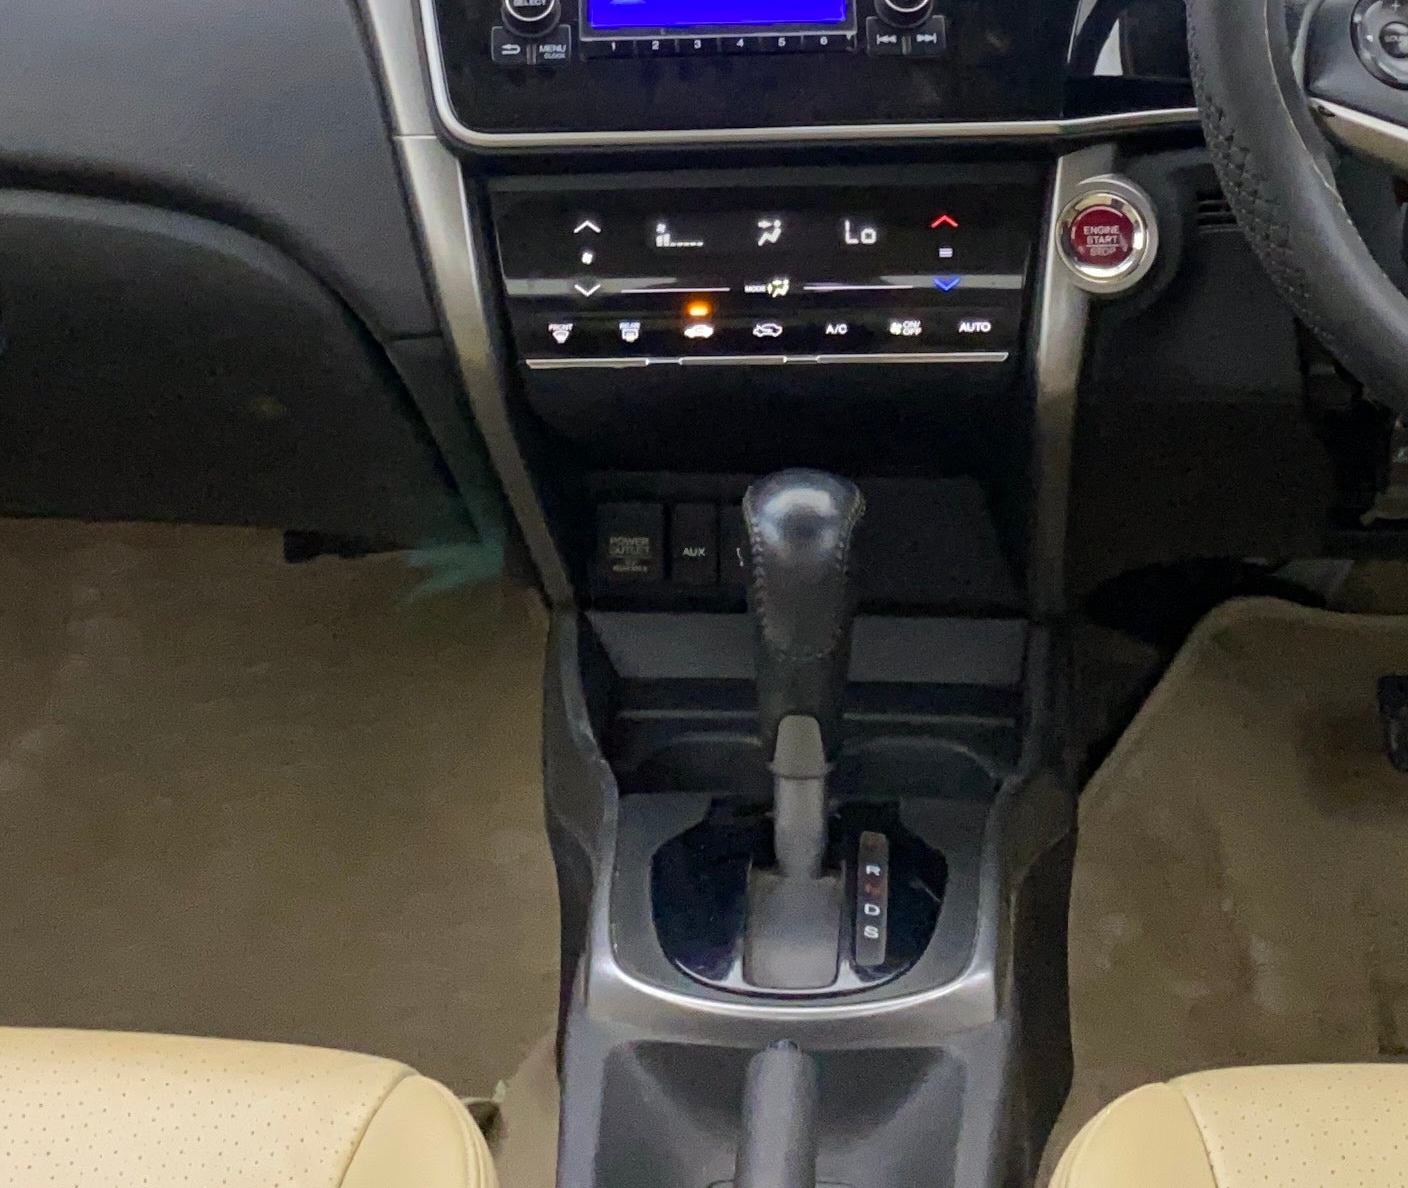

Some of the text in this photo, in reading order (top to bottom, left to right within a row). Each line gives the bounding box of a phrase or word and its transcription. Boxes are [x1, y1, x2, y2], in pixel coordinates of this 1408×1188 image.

[611, 36, 828, 52] 1 2 3 4 5 6
[844, 219, 877, 245] Lo
[1083, 225, 1120, 235] ENGINE
[1086, 235, 1119, 245] START
[744, 284, 767, 294] MODE
[825, 323, 848, 335] A/C
[903, 327, 922, 335] OFF
[958, 321, 992, 333] AUTO
[682, 547, 706, 557] AUX
[864, 903, 880, 916] D
[863, 925, 879, 939] S
